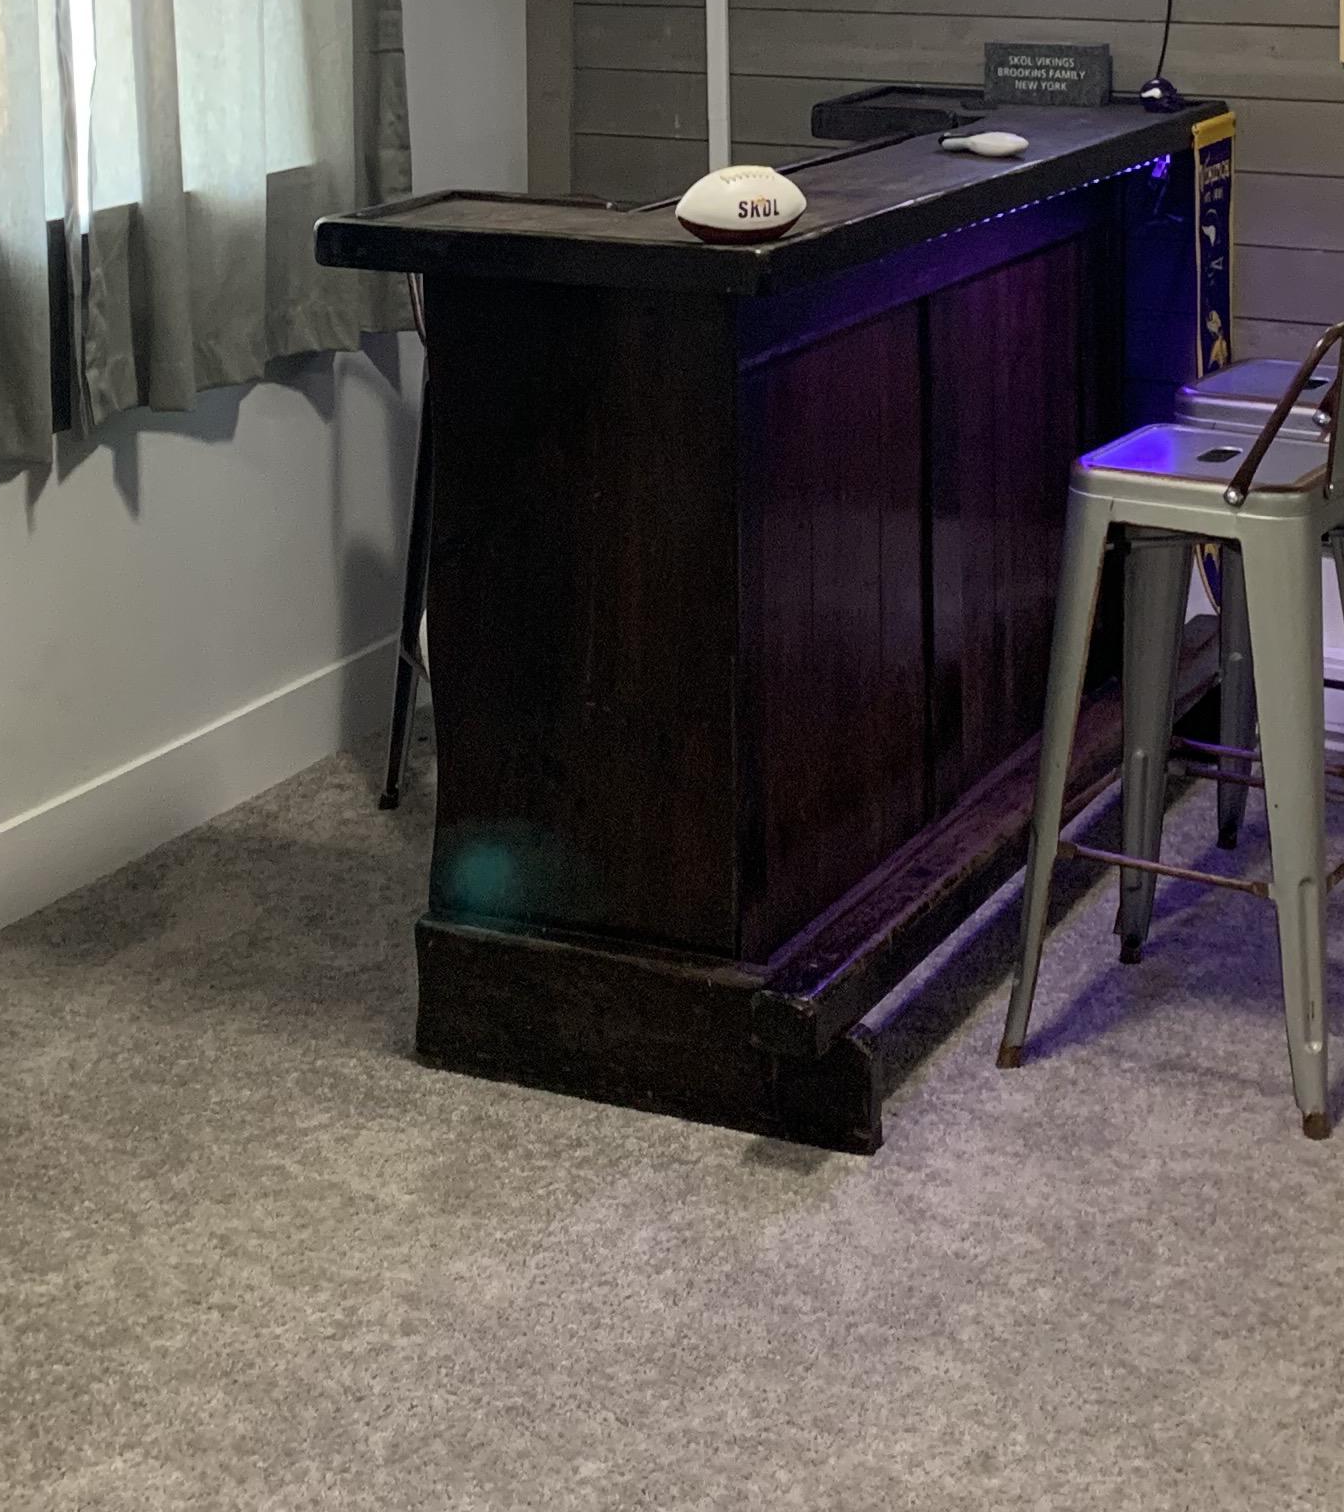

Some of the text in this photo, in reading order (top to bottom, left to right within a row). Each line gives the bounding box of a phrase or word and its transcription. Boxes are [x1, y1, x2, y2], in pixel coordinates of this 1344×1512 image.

[1036, 56, 1074, 68] VIKINGS
[997, 67, 1086, 80] BROOKINS FAMILY
[1015, 79, 1068, 91] NEW YORK
